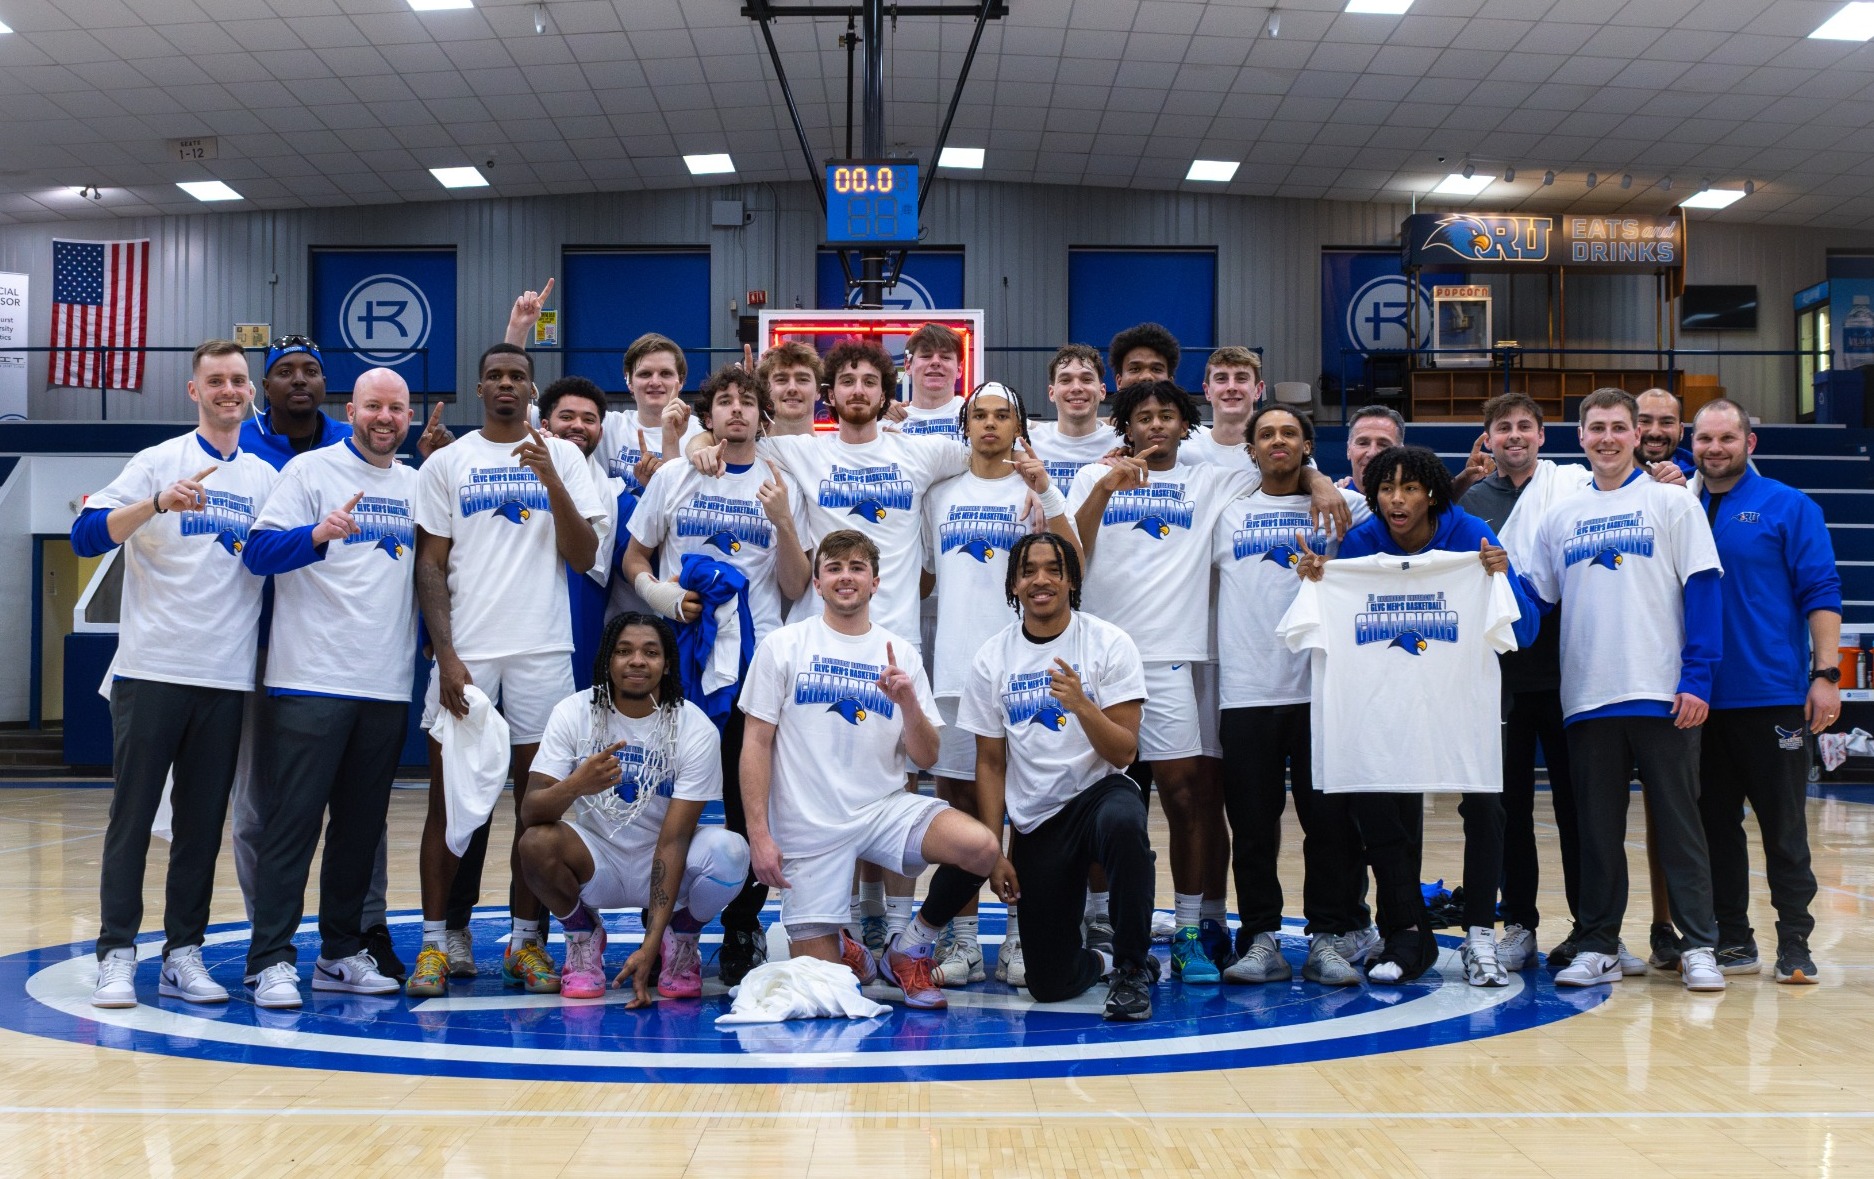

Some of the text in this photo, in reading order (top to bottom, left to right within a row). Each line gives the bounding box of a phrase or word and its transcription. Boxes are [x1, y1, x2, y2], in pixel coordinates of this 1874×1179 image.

[180, 148, 204, 159] 1-12
[835, 167, 893, 193] 00.0
[1571, 218, 1675, 239] EATS and
[1572, 241, 1675, 262] DRINKS
[459, 481, 552, 519] CHAMPION
[818, 479, 914, 511] CHAMPIONS
[676, 507, 773, 549] CHAMPIONS
[1563, 526, 1655, 569] CHAMPIONS
[1386, 602, 1405, 611] MEN'S
[1405, 601, 1442, 611] BASKETBALL
[1355, 611, 1458, 646] CHAMPIONS
[814, 663, 880, 681] GLVC MEN'S BASKETBA
